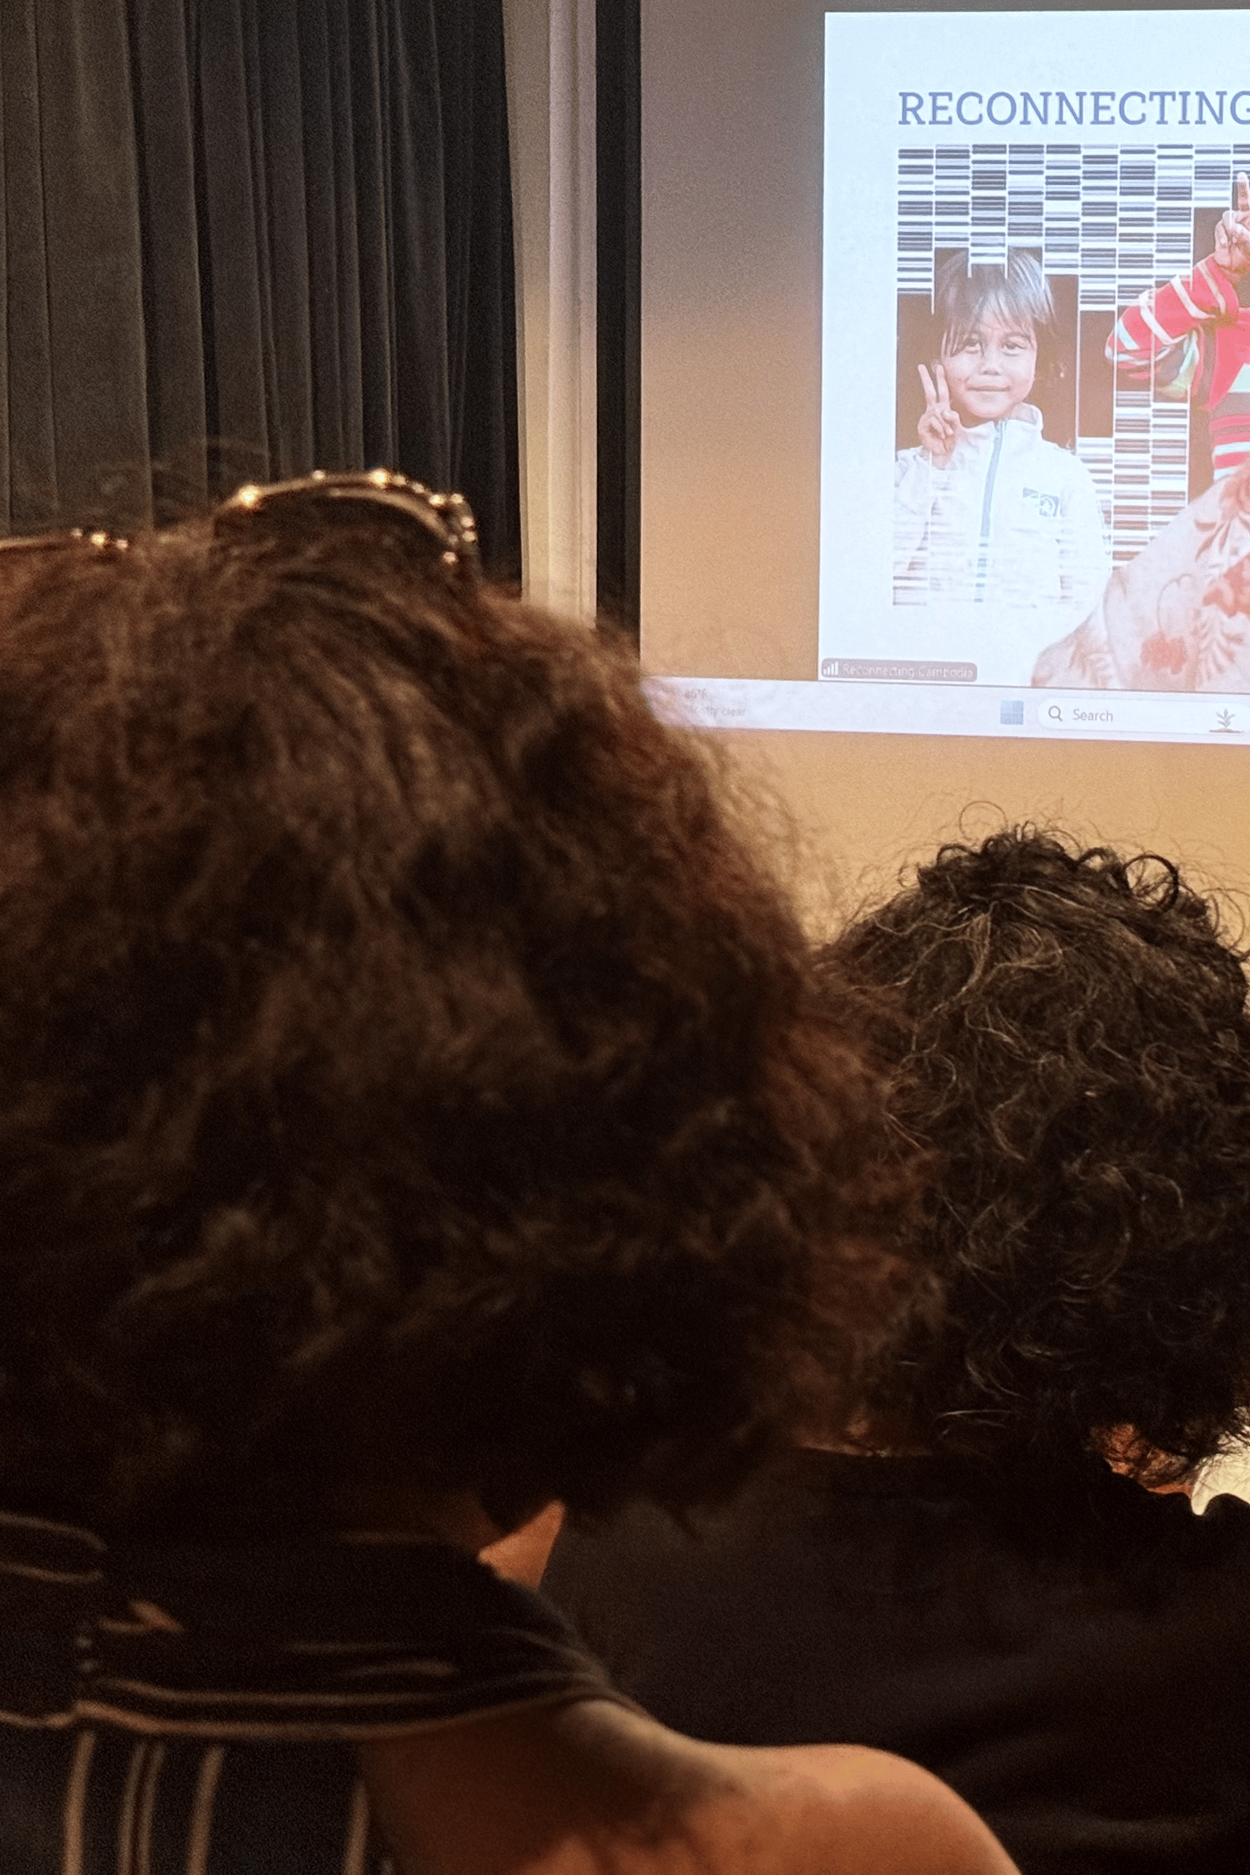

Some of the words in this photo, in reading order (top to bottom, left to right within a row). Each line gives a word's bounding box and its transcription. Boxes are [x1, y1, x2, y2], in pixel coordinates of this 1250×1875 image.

[842, 663, 915, 680] Reconnecting
[918, 665, 974, 679] Cambodia
[1072, 708, 1114, 723] Search
